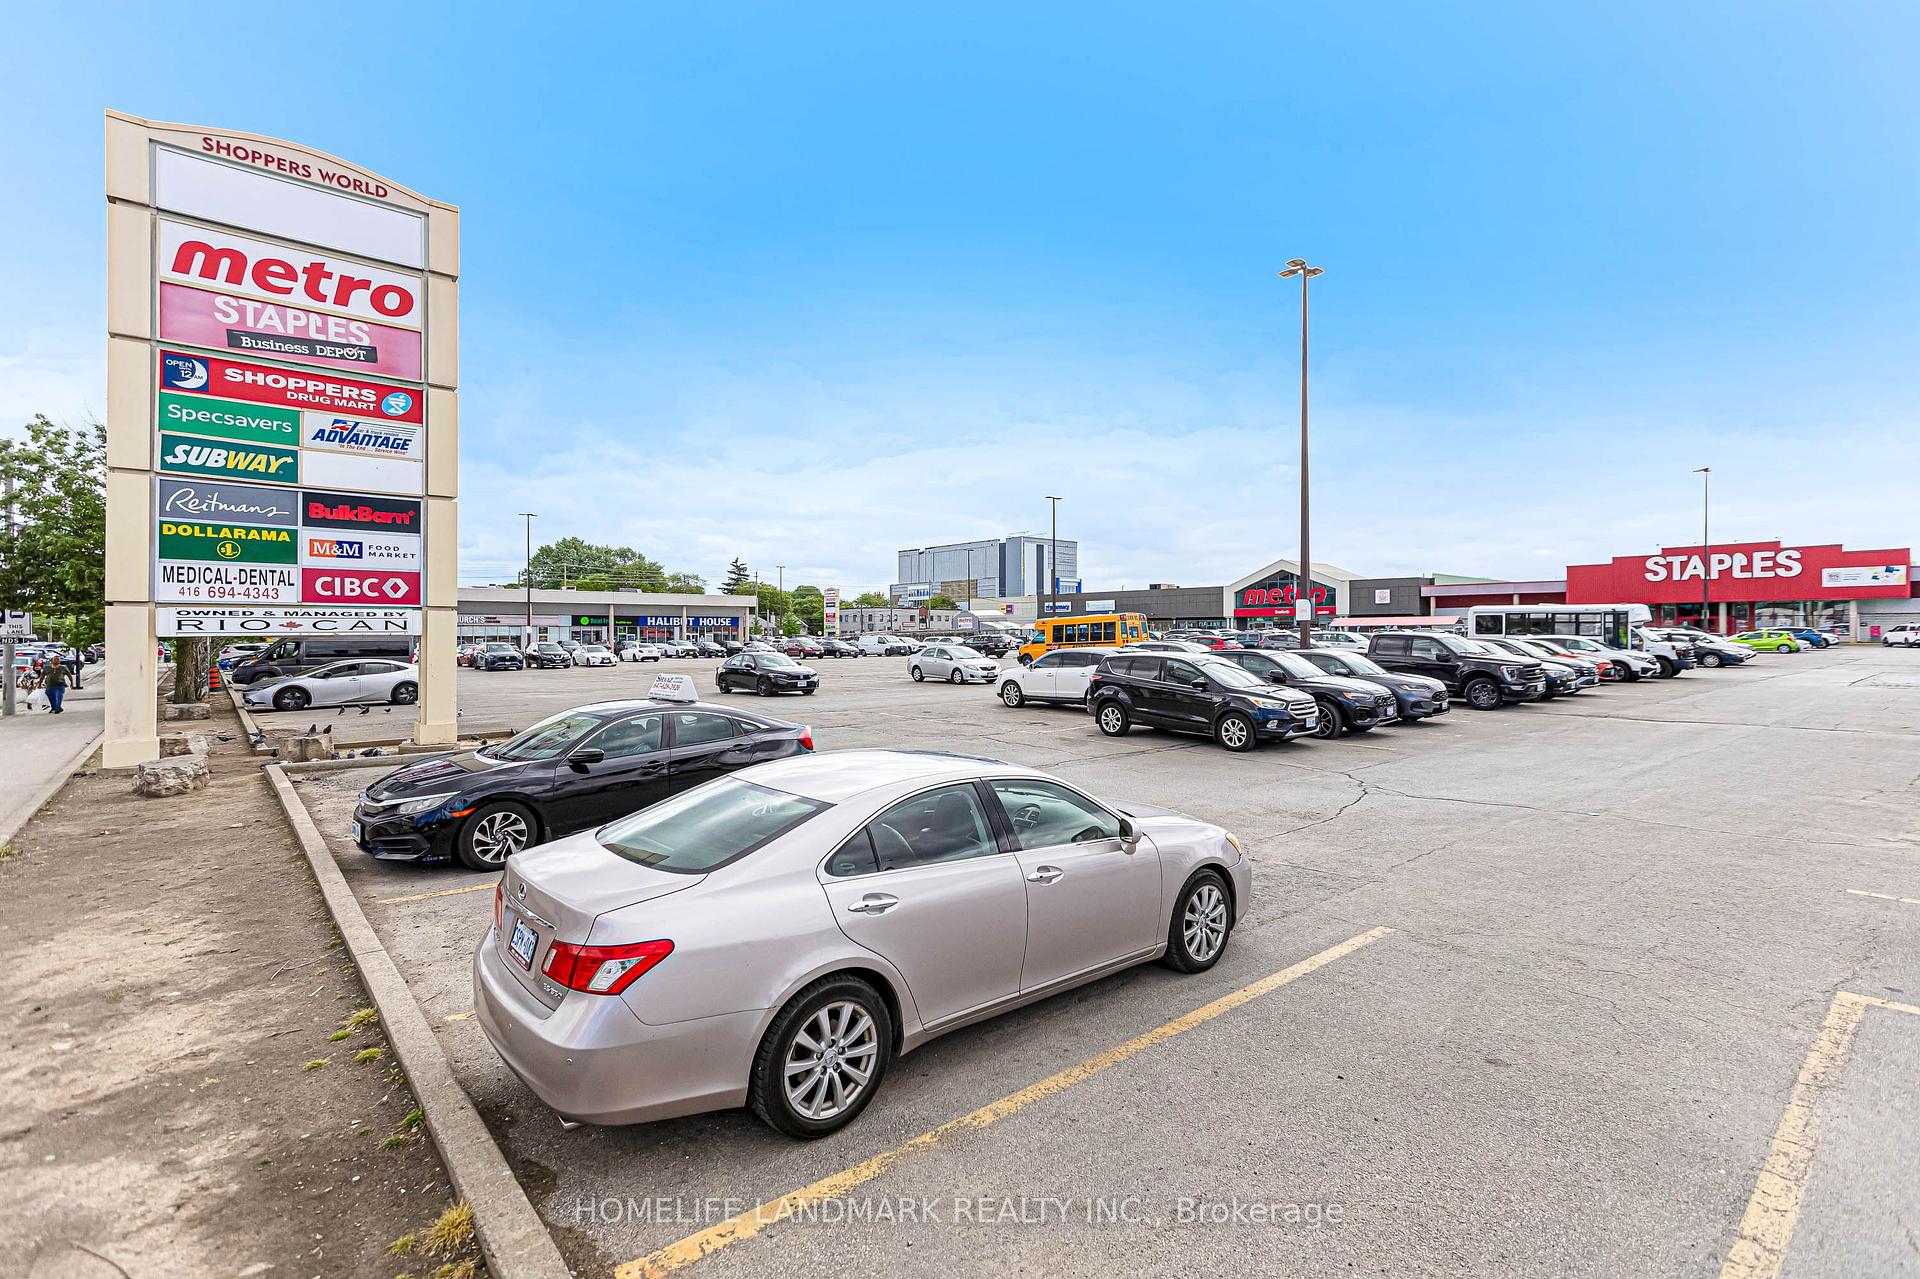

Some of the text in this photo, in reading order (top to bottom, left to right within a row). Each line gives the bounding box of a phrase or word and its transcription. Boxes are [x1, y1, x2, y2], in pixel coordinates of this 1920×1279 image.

[202, 136, 389, 199] SHOPPERS WORLD
[170, 239, 415, 318] metro
[213, 295, 370, 347] STAPLES
[240, 335, 367, 361] Business DEPOT
[165, 359, 193, 368] OPEN
[180, 370, 193, 379] 12
[223, 367, 378, 402] SHOPPERS
[286, 390, 377, 412] DRUG MART
[167, 403, 293, 434] Specsavers
[311, 421, 413, 451] ADVANTAGE
[163, 443, 295, 474] SUBWAY
[165, 487, 290, 518] Reitmans
[162, 523, 291, 542] DOLLARAMA
[312, 541, 361, 557] M&M
[368, 544, 400, 552] FOOD
[368, 551, 416, 559] MARKET
[162, 565, 295, 587] MEDICAL-DENTAL
[1643, 549, 1803, 582] STAPLES
[178, 586, 279, 600] 416 694-4343
[314, 576, 381, 597] CIBC
[176, 609, 255, 617] OWNED
[283, 610, 378, 618] MANAGED
[457, 616, 485, 624] URCH'S
[699, 617, 732, 626] HOUSE
[176, 619, 409, 631] RIO CAN
